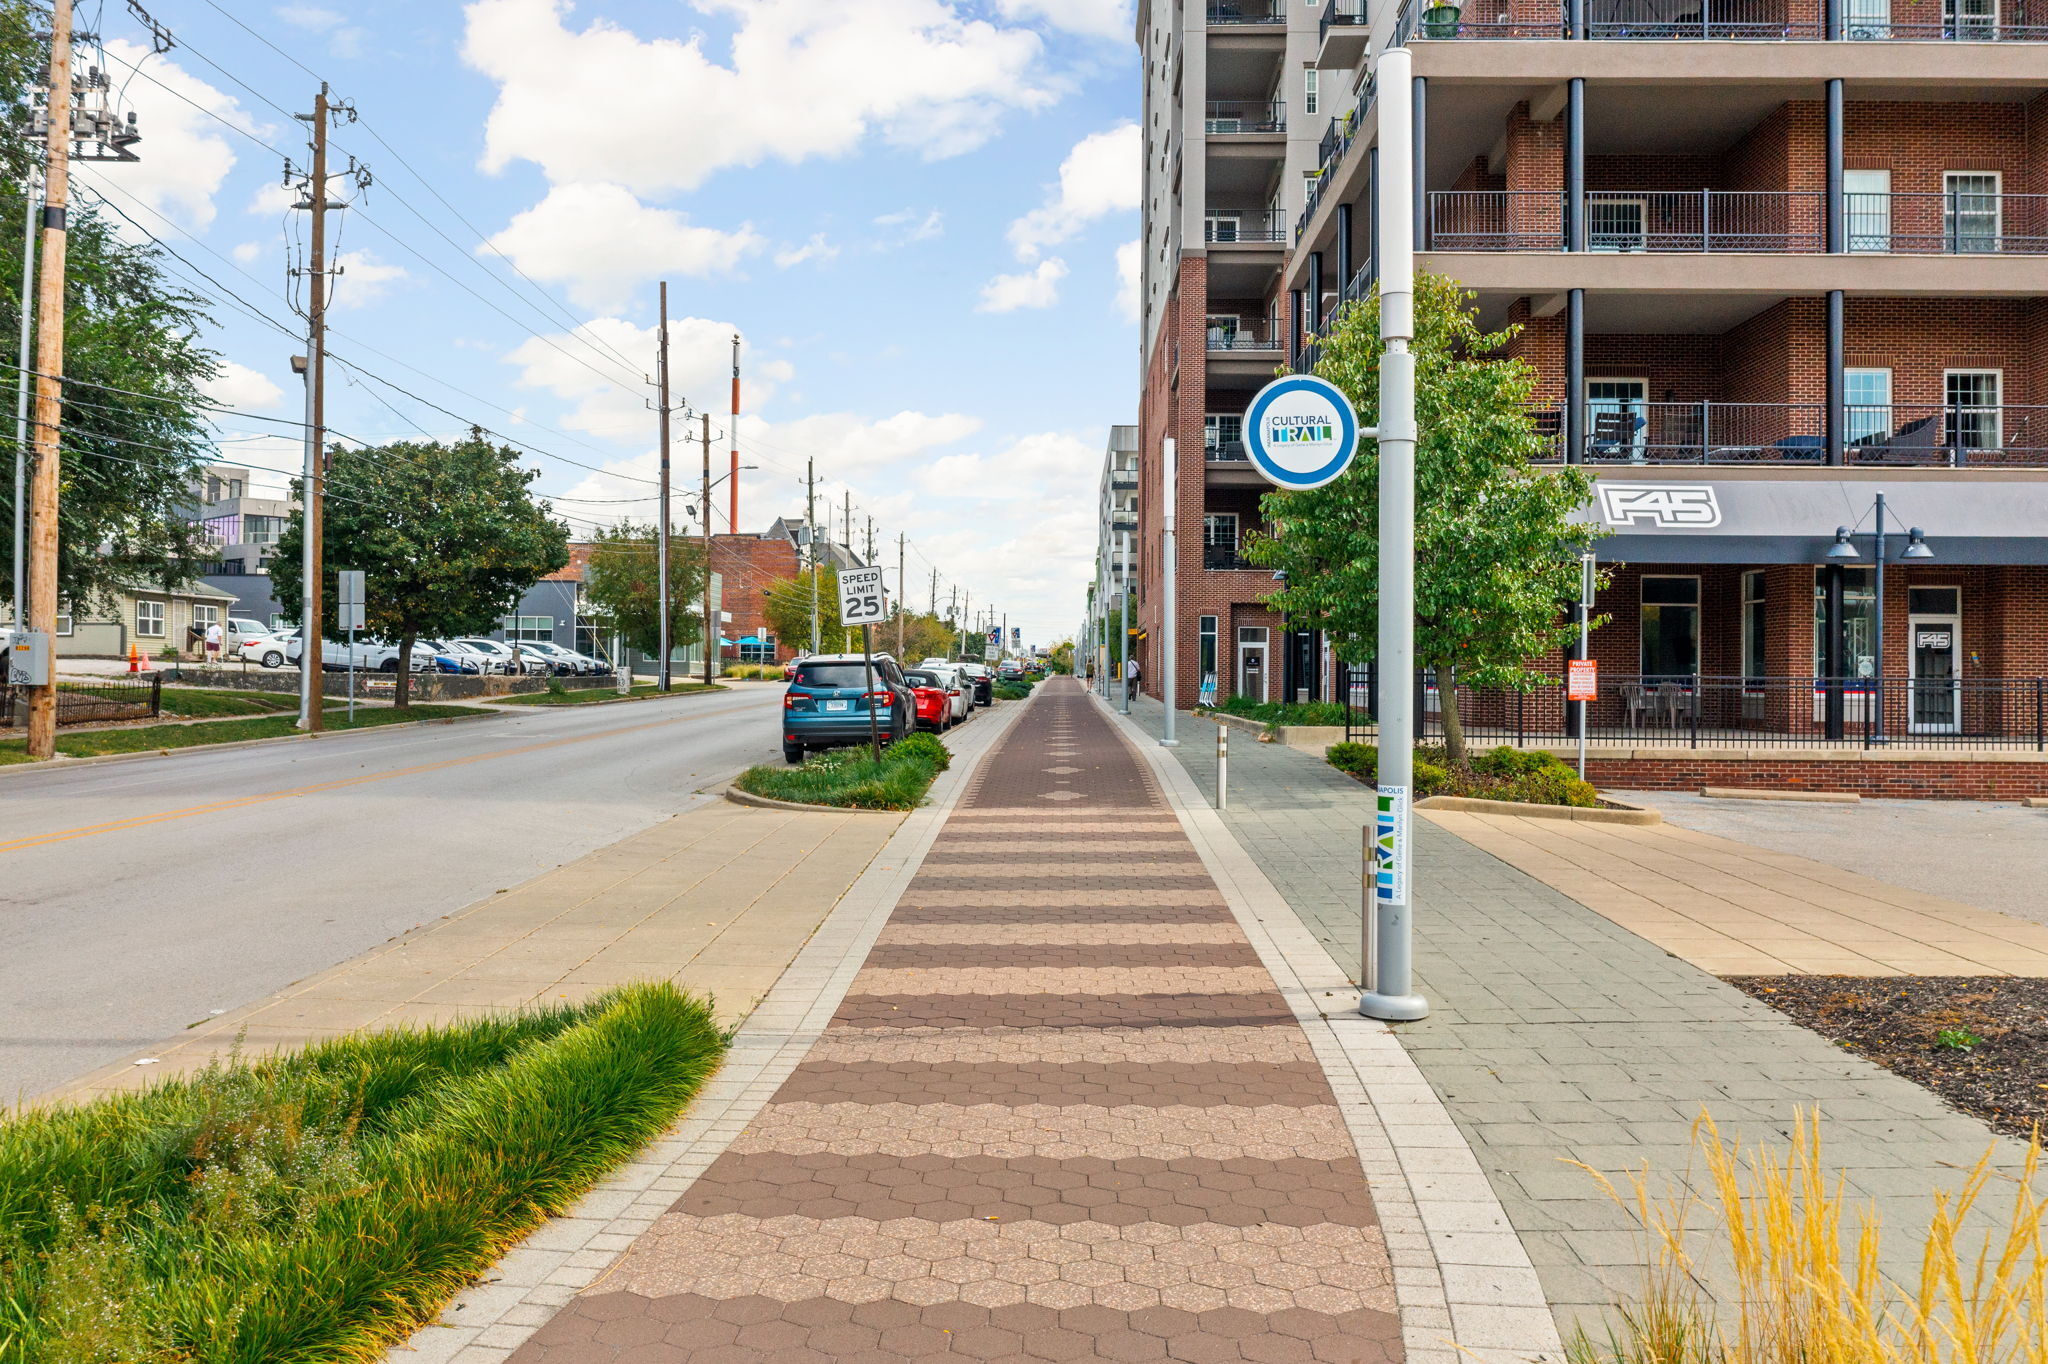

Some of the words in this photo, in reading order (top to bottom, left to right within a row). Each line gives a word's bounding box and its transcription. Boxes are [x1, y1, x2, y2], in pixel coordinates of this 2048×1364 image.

[1272, 415, 1332, 425] CULTURAL
[1272, 425, 1333, 442] TRAIL
[1601, 486, 1719, 526] F45
[842, 573, 878, 584] SPEED
[847, 584, 875, 595] LIMIT
[845, 595, 880, 618] 25
[1918, 633, 1950, 648] F45
[1378, 786, 1404, 794] APOLIS
